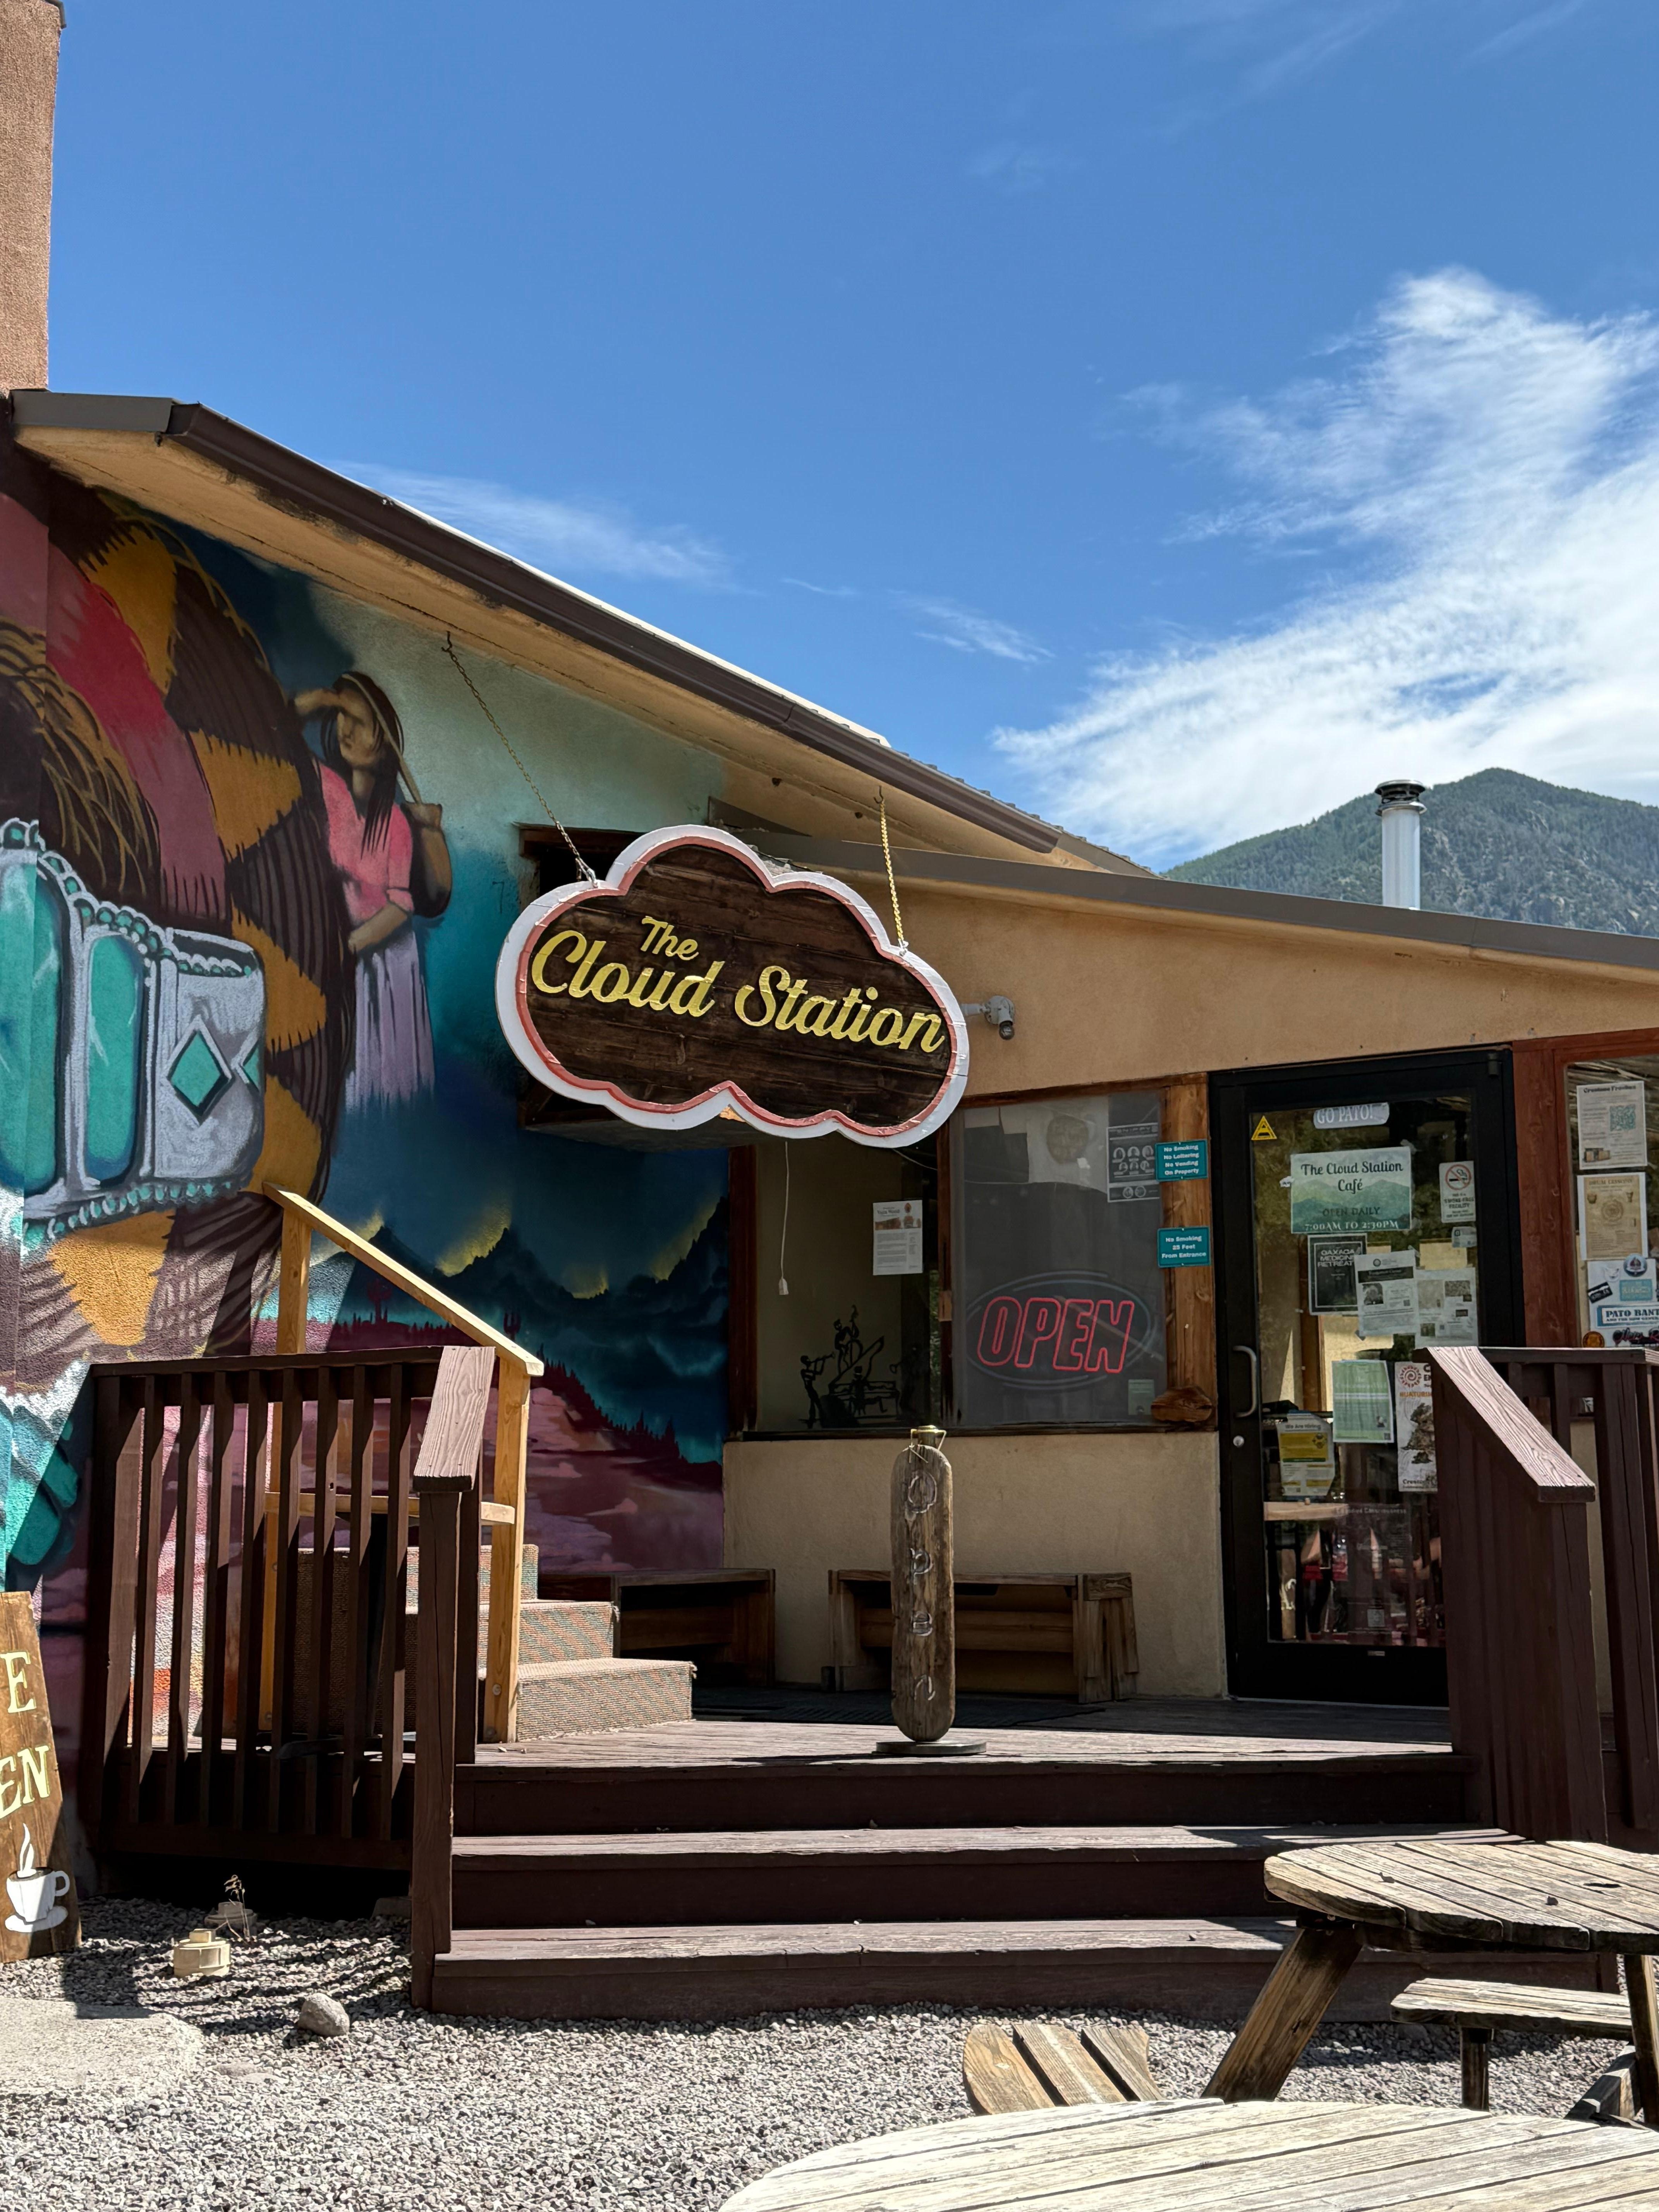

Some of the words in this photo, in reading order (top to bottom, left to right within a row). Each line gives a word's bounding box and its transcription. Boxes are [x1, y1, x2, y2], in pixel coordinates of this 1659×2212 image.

[641, 915, 699, 960] The
[531, 930, 725, 1017] Cloud
[734, 965, 945, 1053] Station
[1317, 1108, 1334, 1124] GO
[1338, 1104, 1373, 1122] PATO!
[1300, 1163, 1324, 1176] The
[1326, 1162, 1359, 1175] Cloud
[1361, 1161, 1404, 1173] Station
[1338, 1178, 1363, 1194] Café
[1322, 1207, 1348, 1216] OPEN
[1352, 1207, 1381, 1216] DAILY
[1305, 1221, 1341, 1231] 7:00AM
[1345, 1221, 1358, 1230] TO
[977, 1296, 1134, 1373] OPEN
